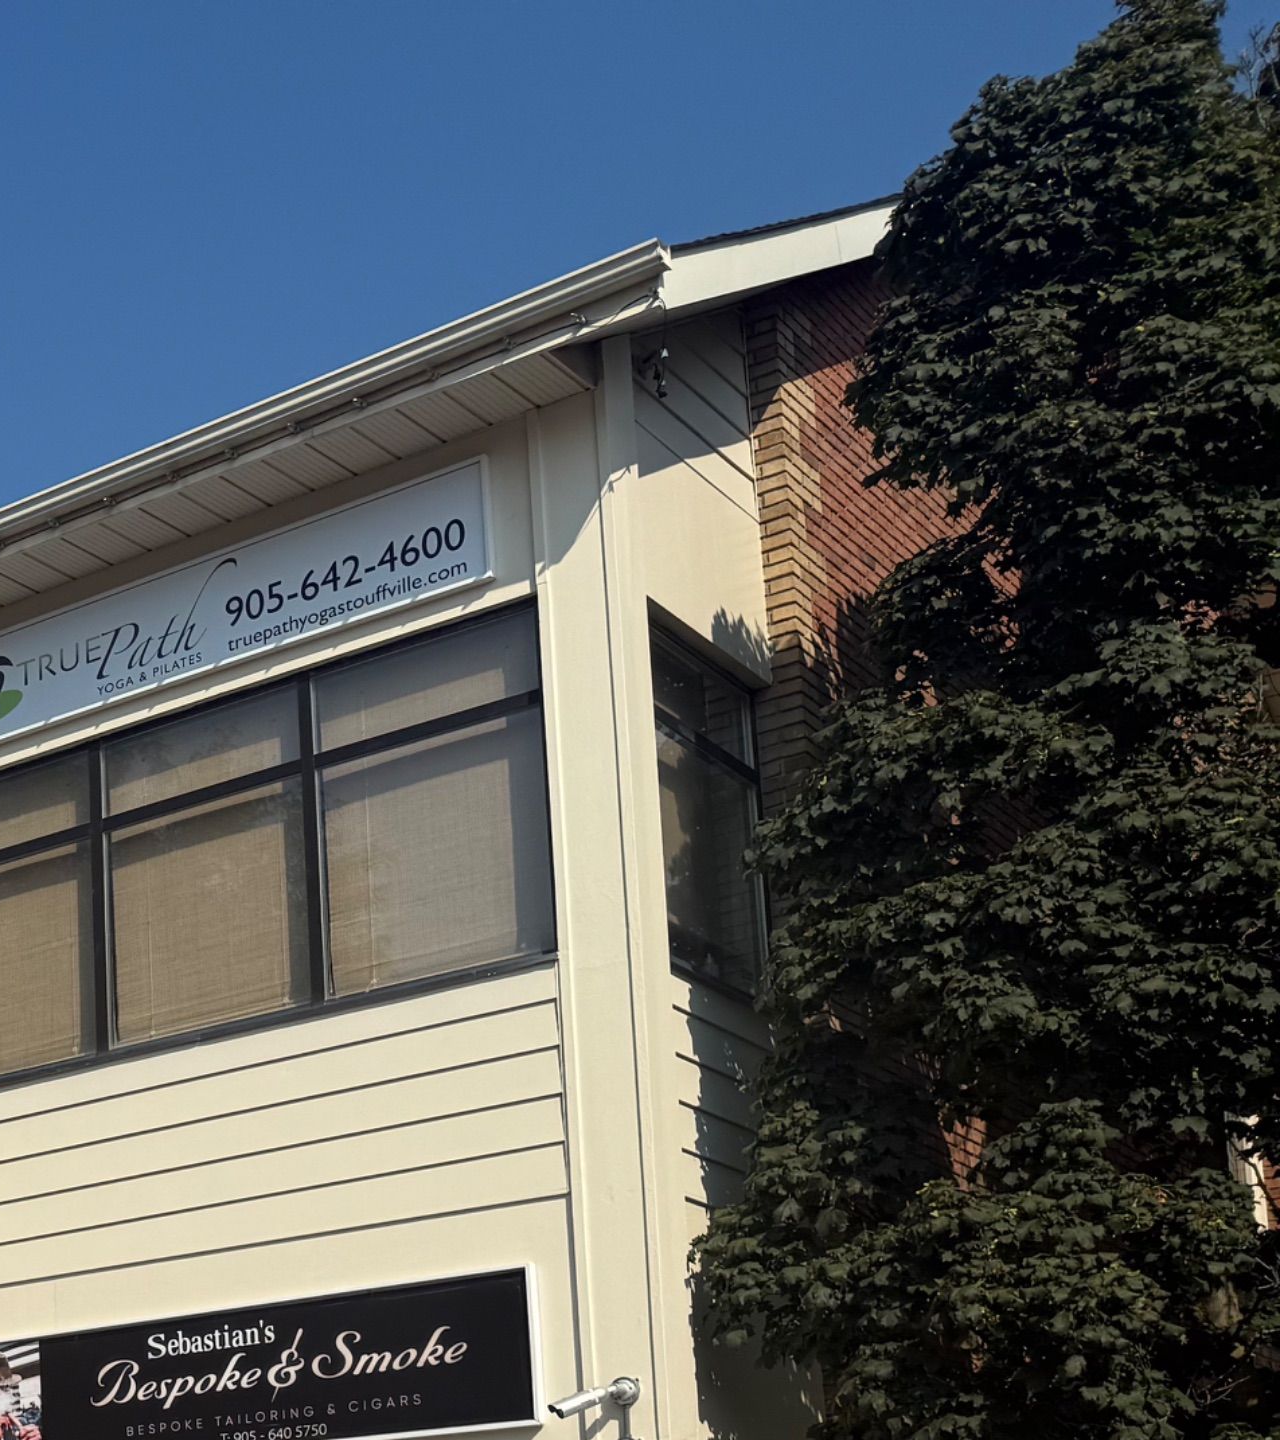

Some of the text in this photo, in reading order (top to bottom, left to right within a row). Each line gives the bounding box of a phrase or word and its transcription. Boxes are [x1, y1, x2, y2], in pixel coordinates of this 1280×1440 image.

[225, 518, 466, 627] 905-642-4600
[228, 561, 468, 652] truepathyogastouffville.com
[97, 651, 203, 696] YOGA & PILATES
[147, 1319, 275, 1359] Sebastian's
[90, 1325, 468, 1410] Bespoke & Smoke
[126, 1393, 423, 1437] BESPOKE TAILORING & CIGARS
[268, 1427, 291, 1440] 640
[294, 1423, 328, 1439] 5750
